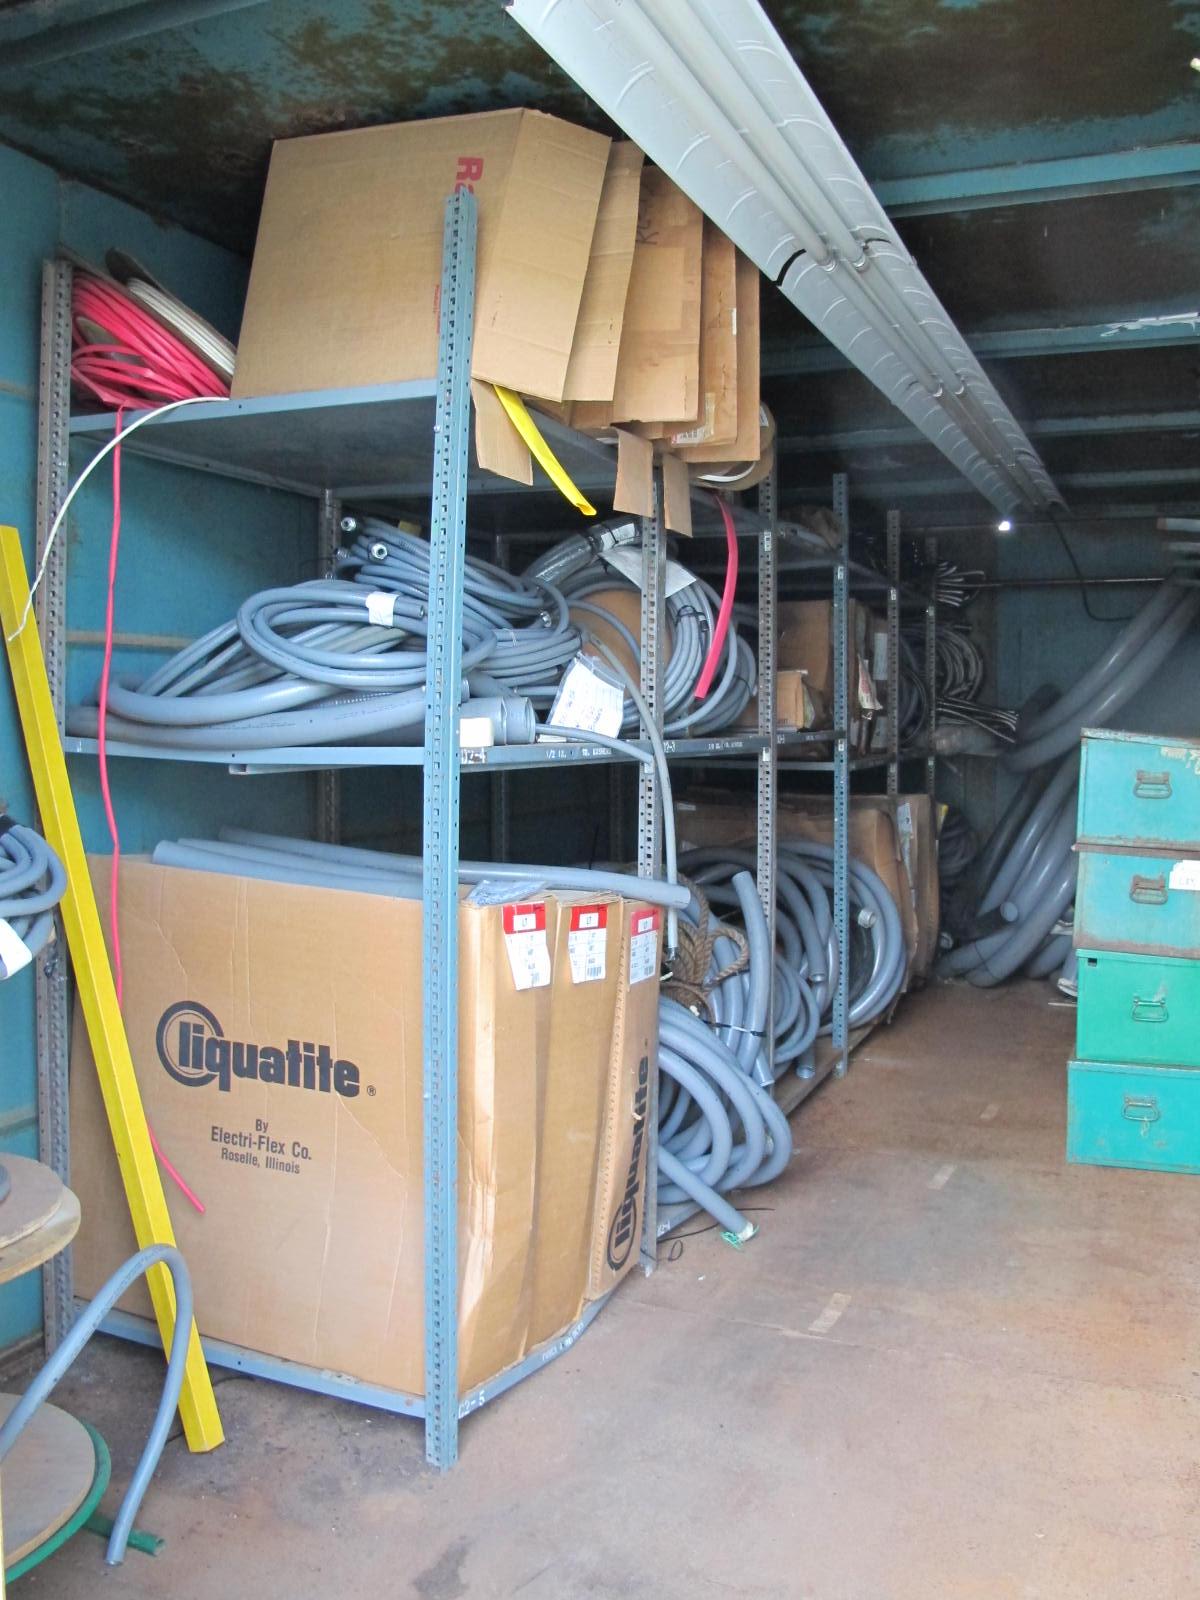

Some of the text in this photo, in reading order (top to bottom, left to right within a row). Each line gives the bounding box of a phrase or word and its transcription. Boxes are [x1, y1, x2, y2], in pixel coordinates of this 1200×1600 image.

[178, 1020, 361, 1098] liquatite
[255, 1118, 269, 1134] By
[211, 1125, 312, 1161] Electri-Flex Co.
[221, 1147, 301, 1175] Roselle, Illinois
